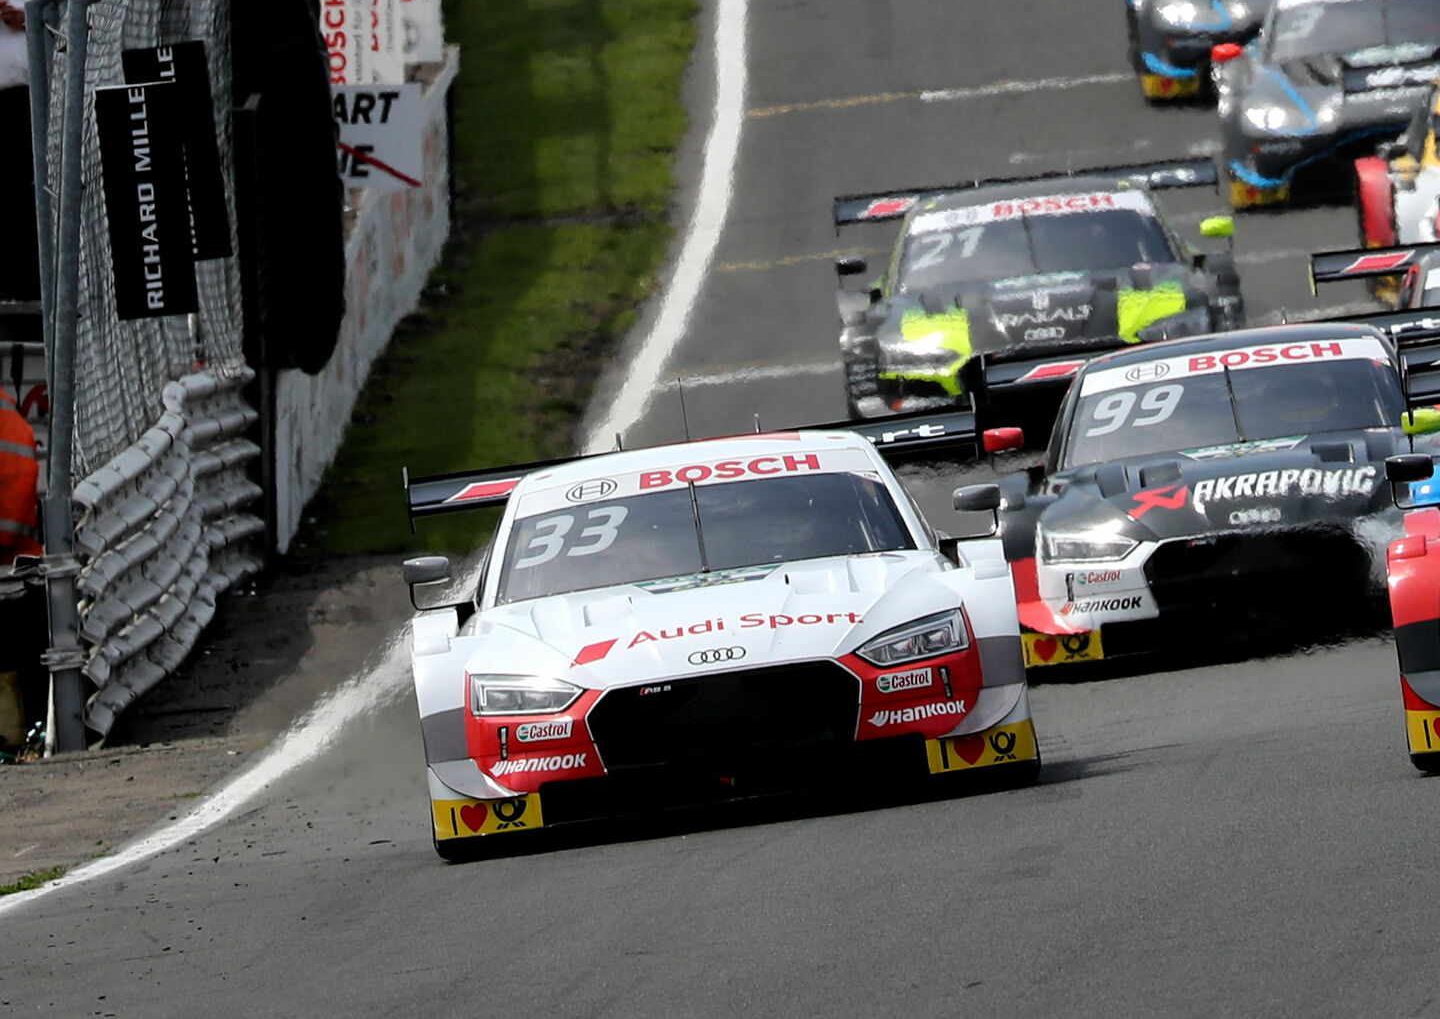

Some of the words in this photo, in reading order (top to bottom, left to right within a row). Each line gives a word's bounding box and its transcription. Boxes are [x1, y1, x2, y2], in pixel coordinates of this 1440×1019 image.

[127, 86, 152, 172] MILLE
[993, 194, 1115, 218] BOSCH
[137, 183, 165, 309] RICHARD
[910, 227, 985, 272] 21
[1188, 342, 1344, 373] BOSCH
[1085, 384, 1186, 438] 99
[639, 454, 821, 490] BOSCH
[514, 505, 629, 570] 33
[1087, 569, 1122, 585] Castrol
[627, 618, 724, 650] Audi
[740, 611, 865, 630] Sport
[892, 670, 930, 689] Castrol
[530, 722, 569, 740] Castrol
